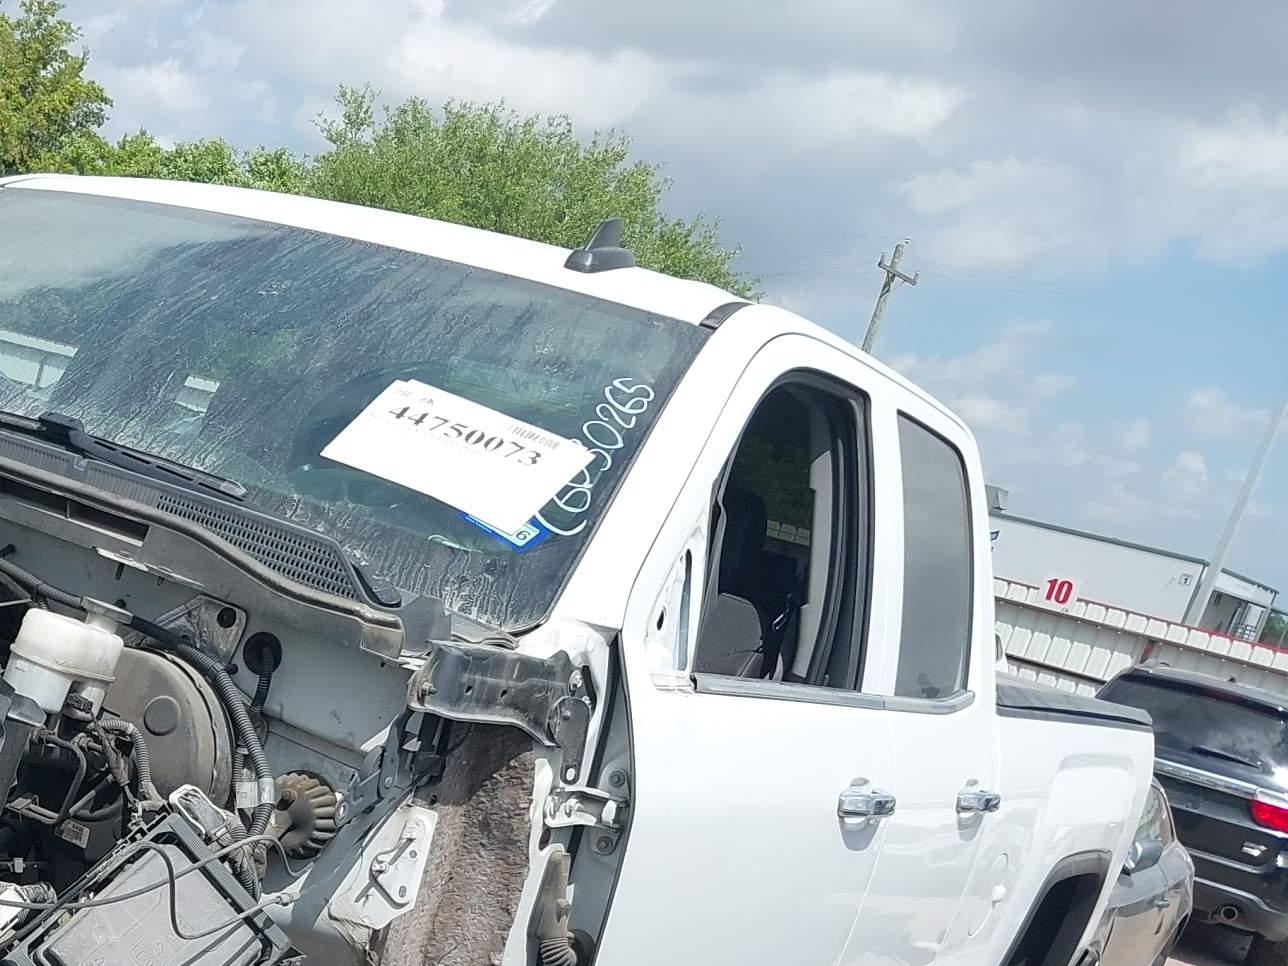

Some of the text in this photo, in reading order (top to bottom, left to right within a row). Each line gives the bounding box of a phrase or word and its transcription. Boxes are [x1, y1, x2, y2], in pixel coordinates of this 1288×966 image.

[389, 405, 542, 465] 44750073
[515, 530, 531, 541] 6
[1045, 578, 1073, 604] 10
